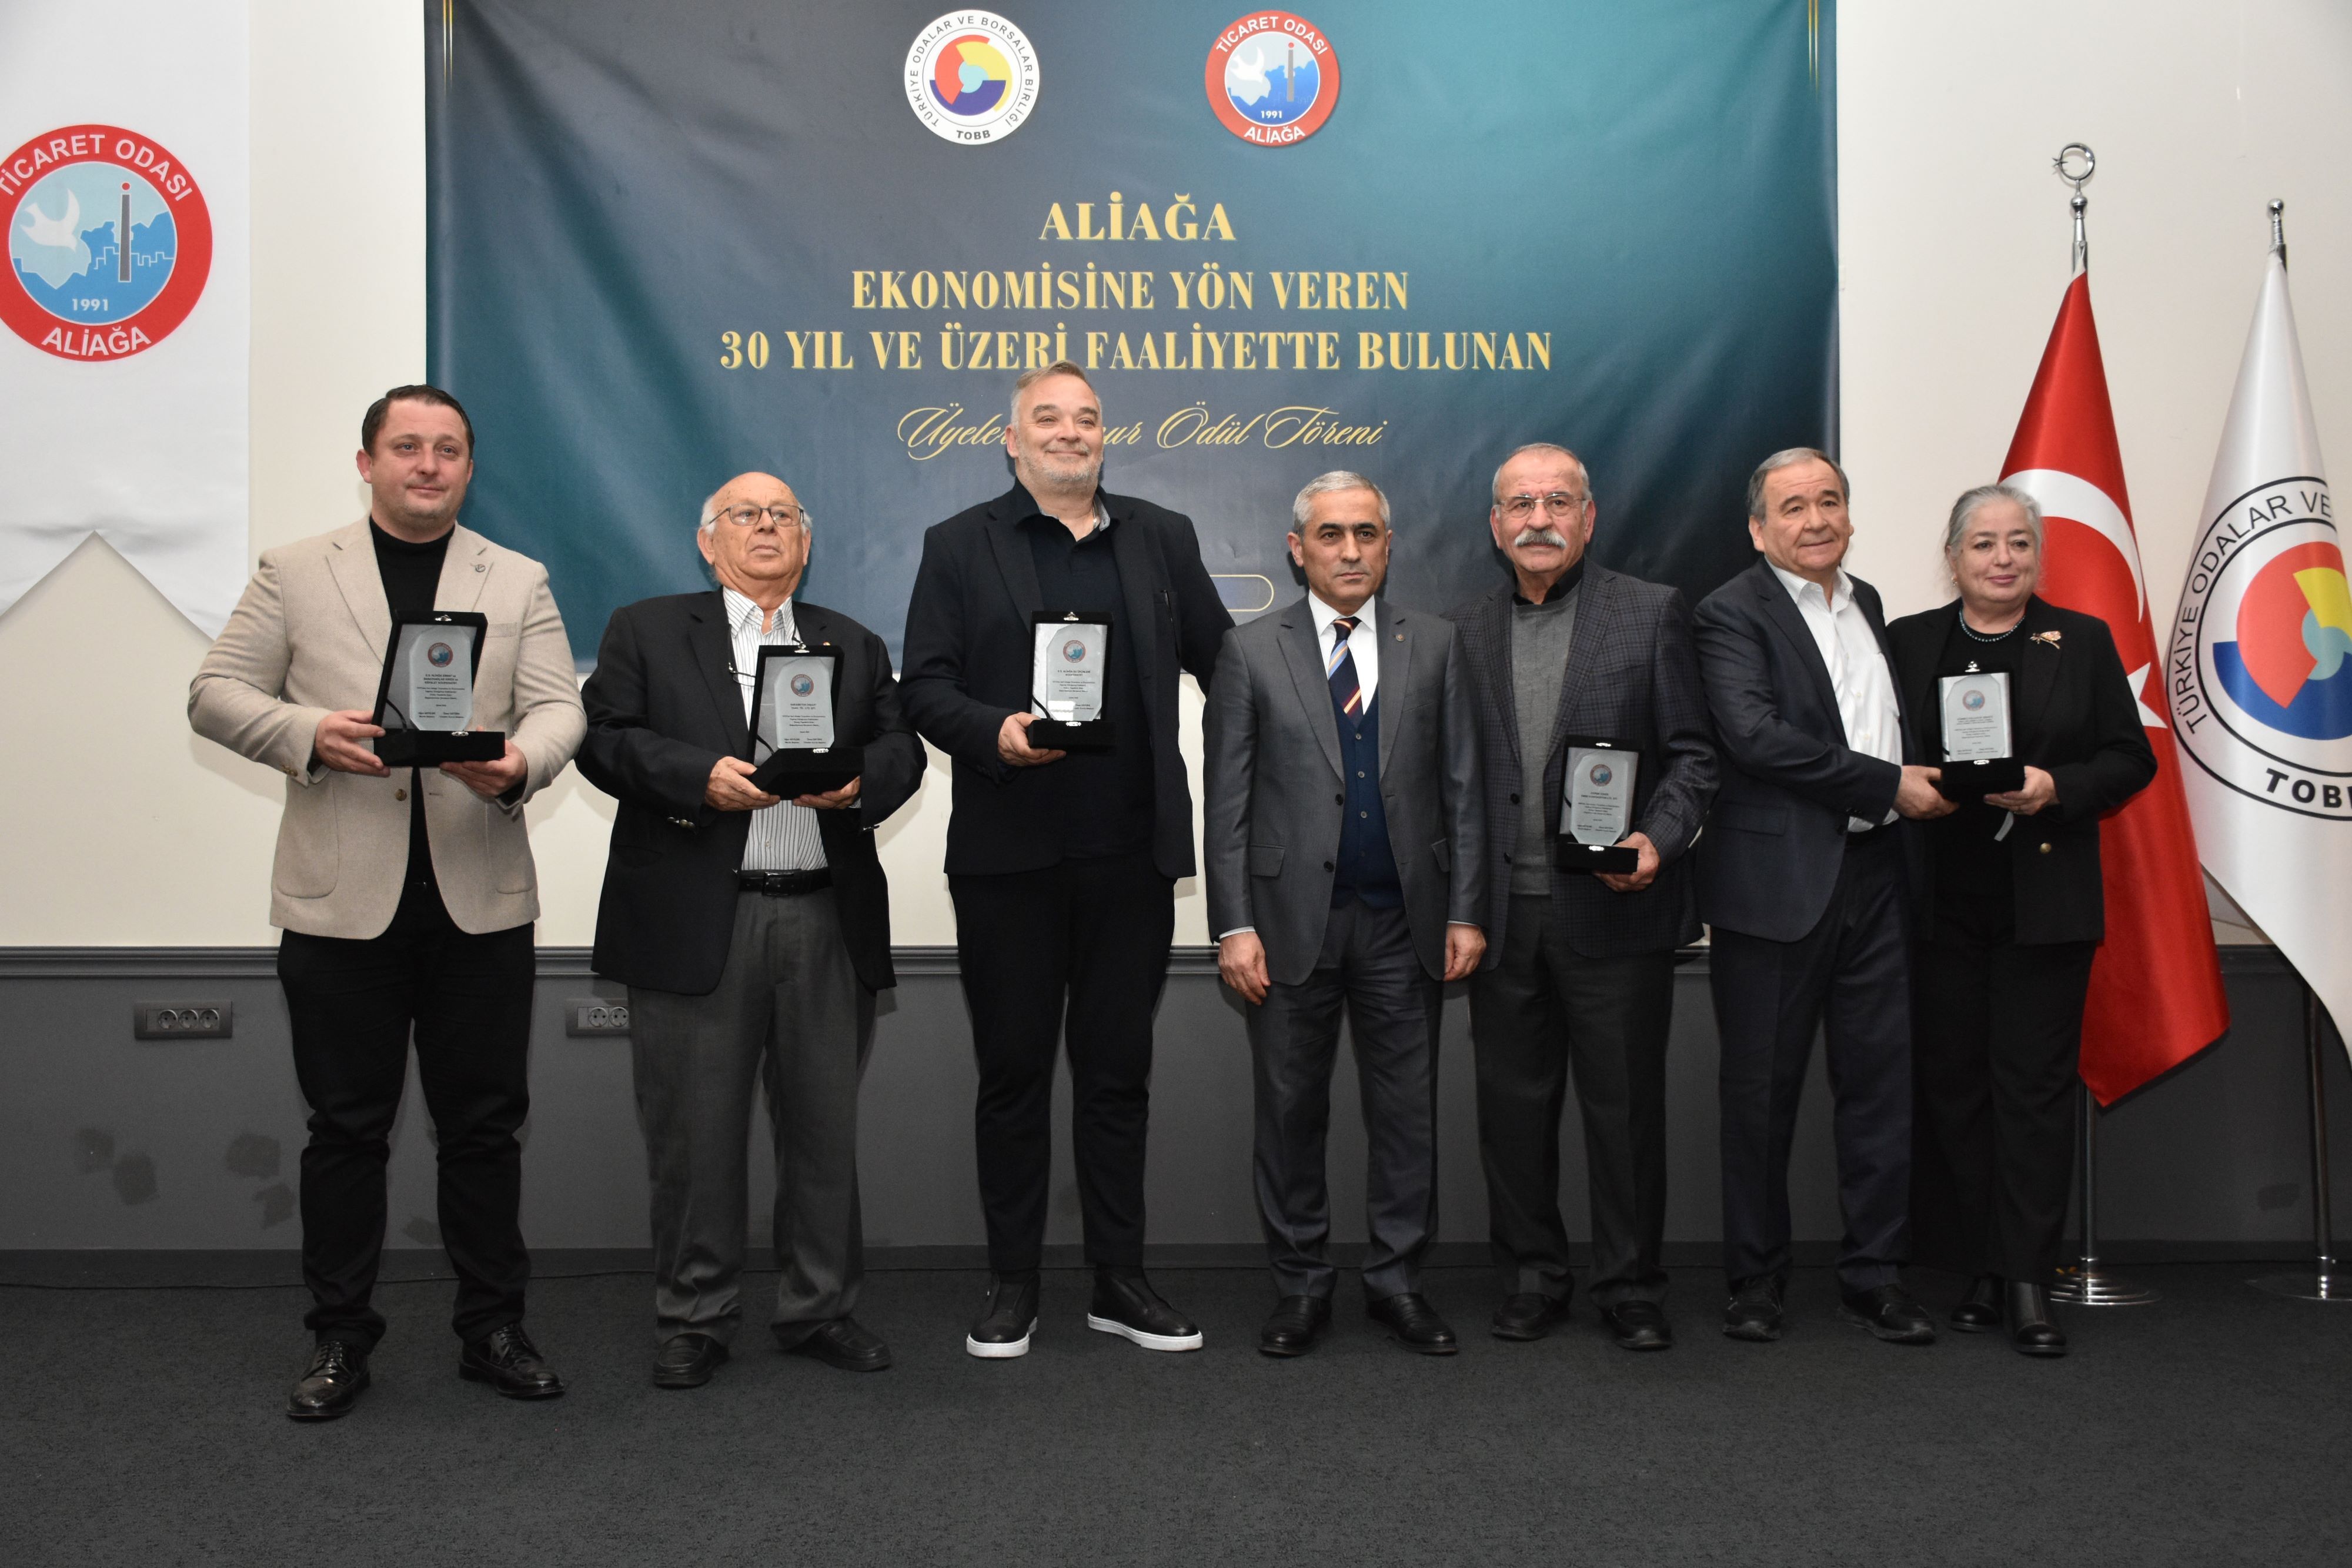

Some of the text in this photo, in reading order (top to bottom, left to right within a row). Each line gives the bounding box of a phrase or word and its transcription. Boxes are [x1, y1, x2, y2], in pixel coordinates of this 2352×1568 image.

[1216, 16, 1328, 55] TİCARET ODASI
[910, 16, 1034, 127] TÜRKİYE ODALAR VE BORSALAR BİRLİĞİ
[956, 130, 990, 140] TOBB
[1244, 126, 1305, 143] ALİAĞA
[0, 134, 193, 202] TİCARET ODASI
[1038, 191, 1237, 240] ALİAĞA
[72, 298, 109, 311] 1991
[852, 262, 1409, 310] EKONOMİSİNE YÖN VEREN
[41, 326, 152, 356] ALİAĞA
[720, 322, 1551, 370] 30 YIL VE ÜZERİ FAALİYETTE BULUNAN
[1157, 402, 1266, 448] Ödül
[1264, 406, 1388, 448] Töreni
[2192, 495, 2293, 594] ODALAR
[2300, 491, 2331, 518] VE
[2266, 768, 2352, 809] TOB
